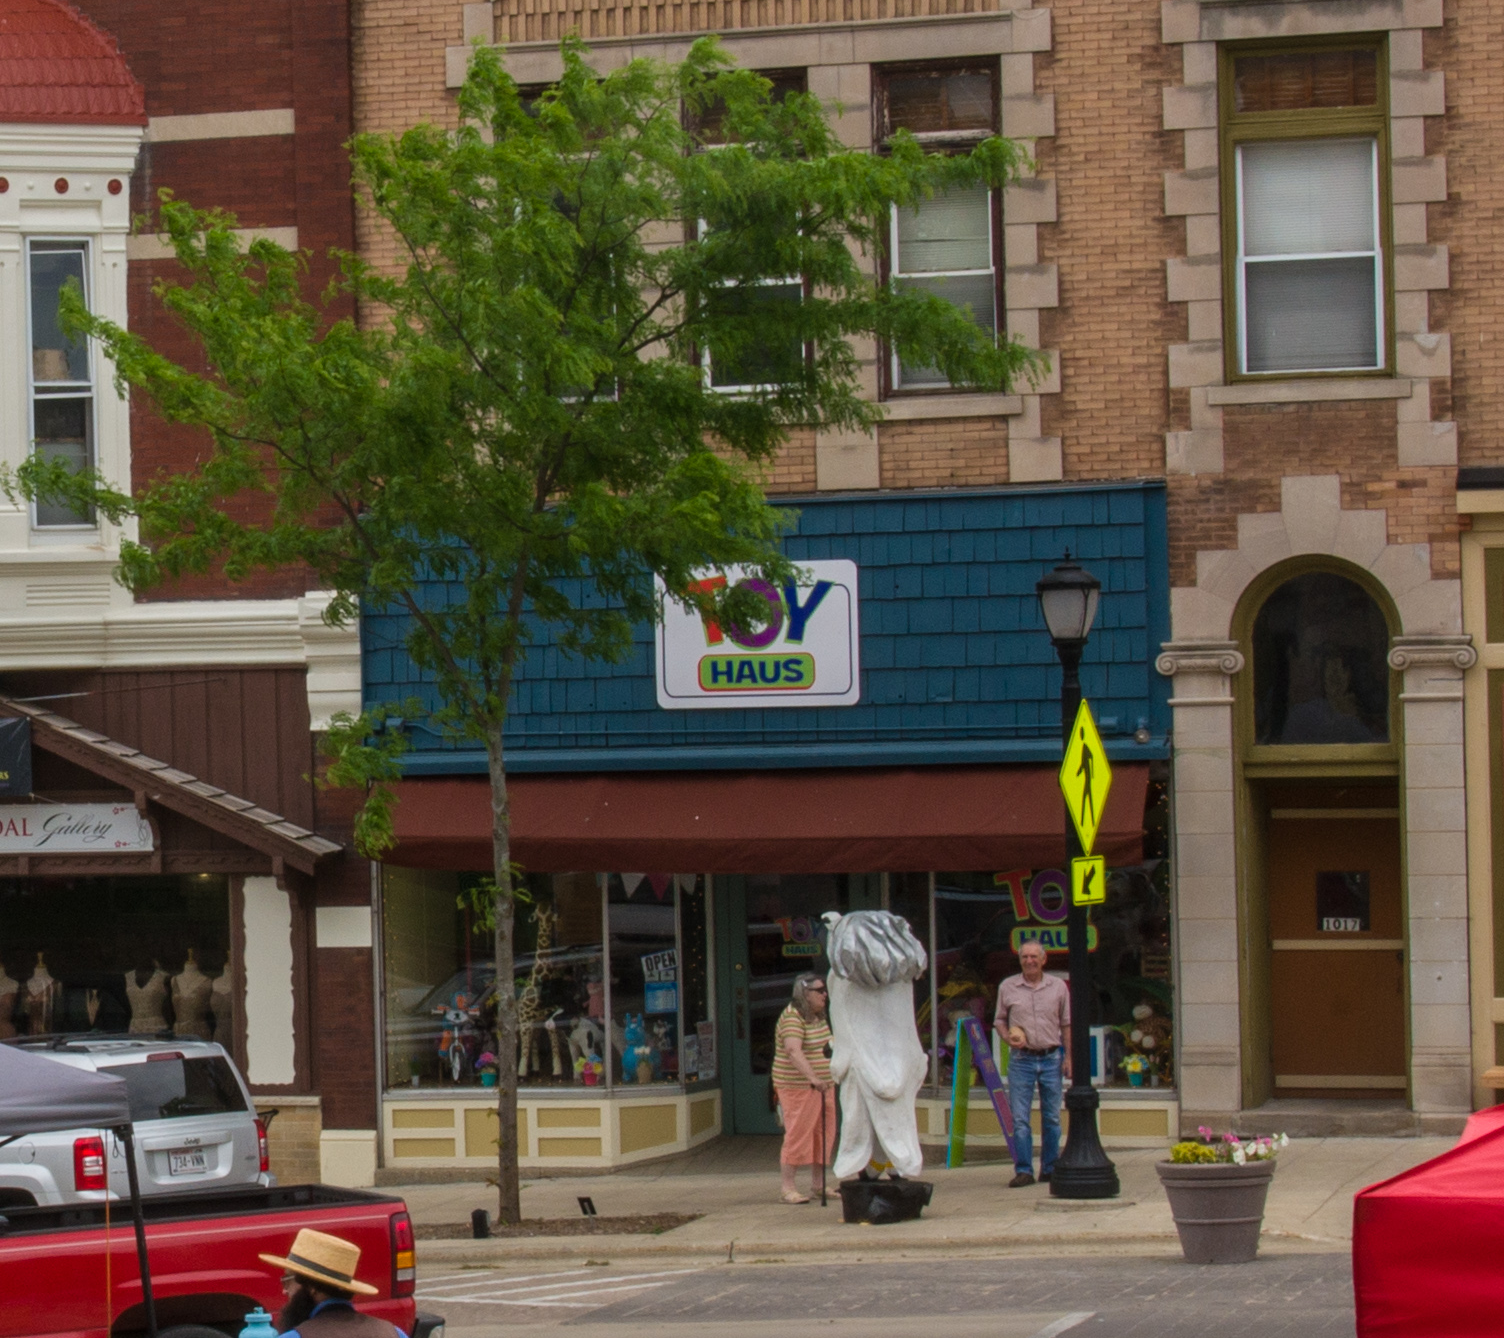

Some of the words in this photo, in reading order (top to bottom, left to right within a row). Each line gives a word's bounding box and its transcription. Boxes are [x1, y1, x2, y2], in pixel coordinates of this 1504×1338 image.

[680, 575, 835, 651] TOY
[711, 659, 805, 684] HAUS
[35, 812, 114, 846] Gallery
[994, 869, 1092, 924] TO
[775, 917, 827, 943] TOY
[1323, 918, 1360, 931] 1017
[1019, 929, 1080, 948] HAU
[644, 951, 677, 972] OPEN
